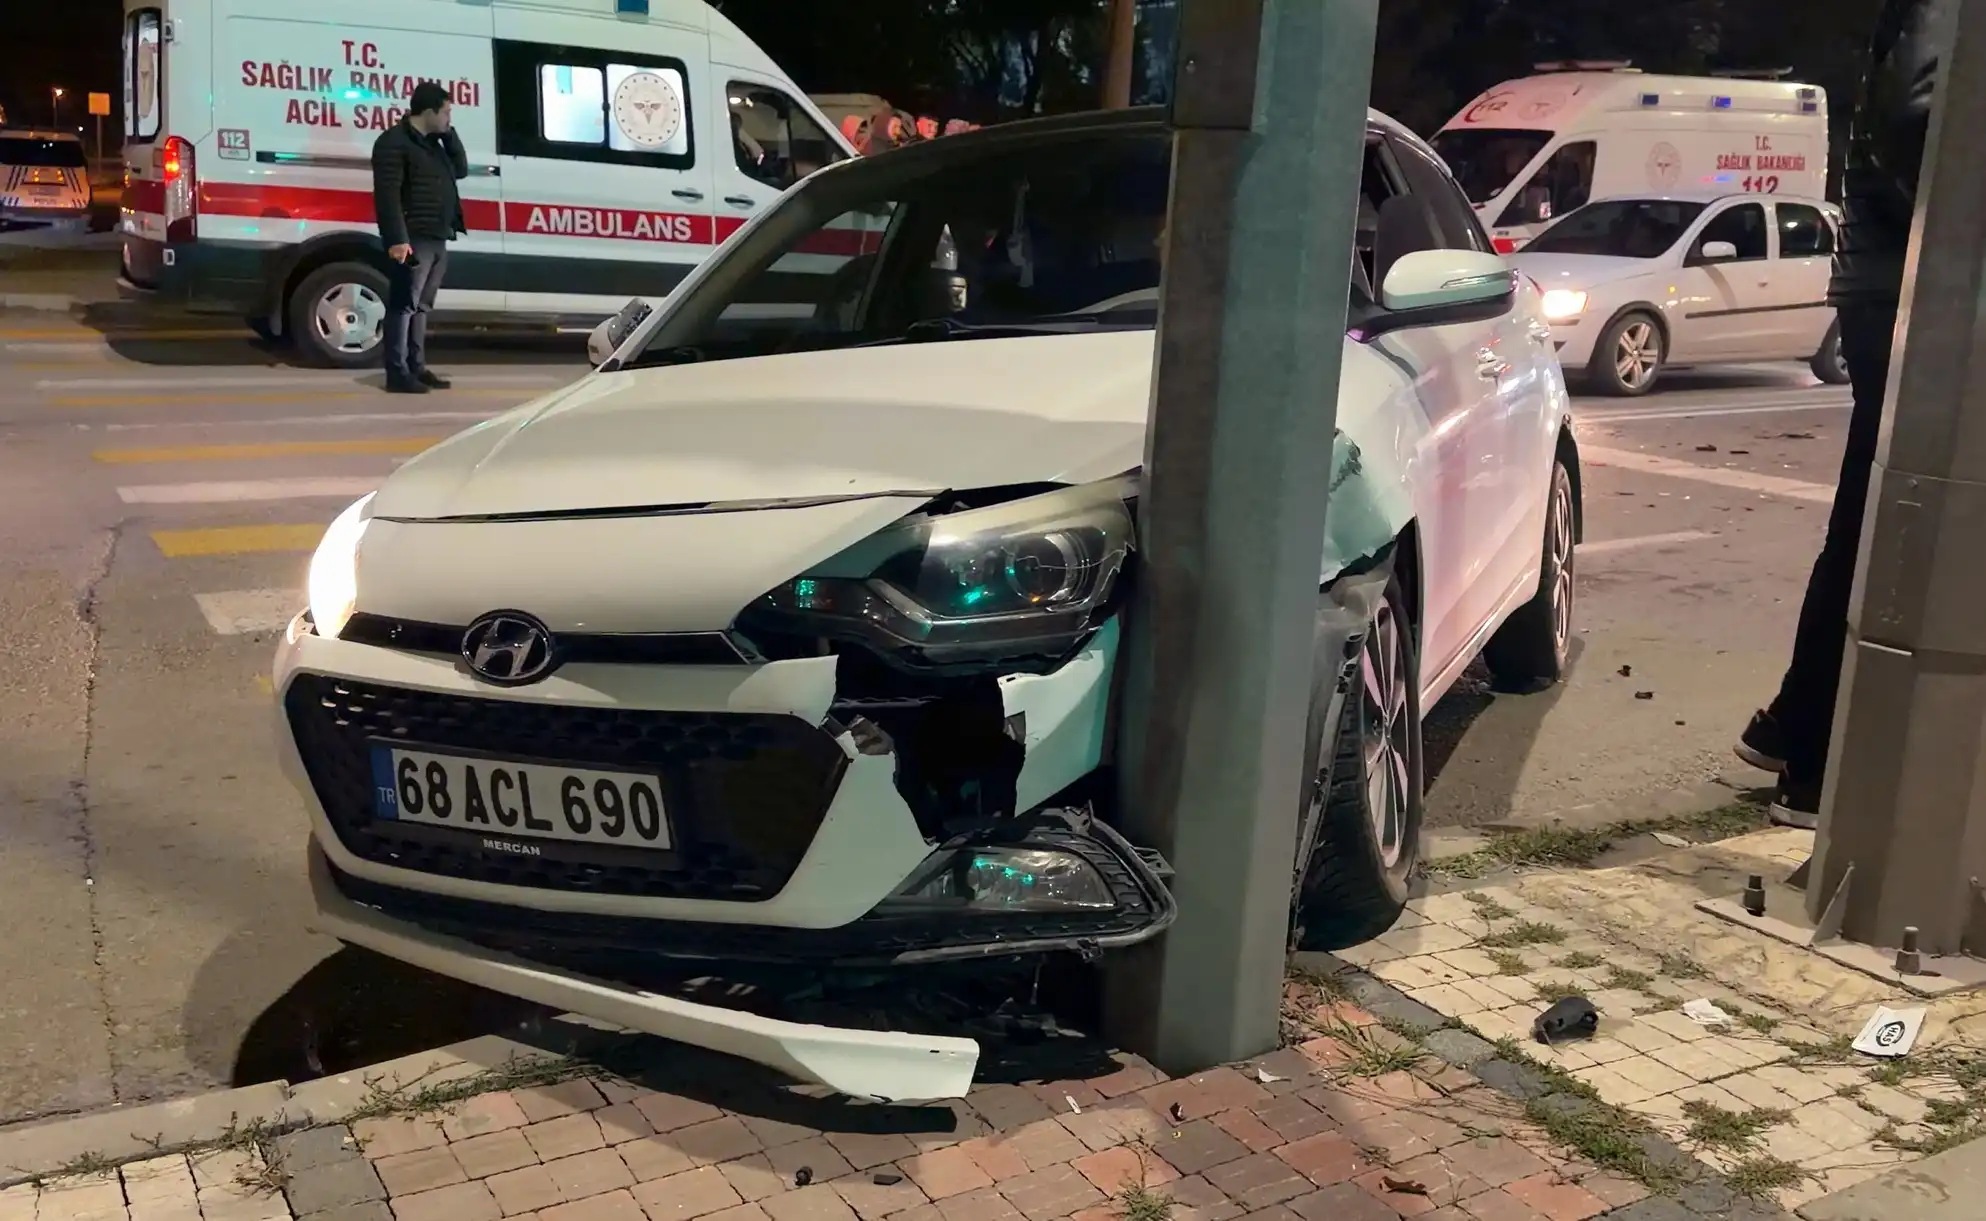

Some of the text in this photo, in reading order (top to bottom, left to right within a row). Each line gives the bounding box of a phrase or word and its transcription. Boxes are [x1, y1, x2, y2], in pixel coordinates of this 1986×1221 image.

[341, 39, 386, 69] T.C.
[241, 58, 480, 107] SAĞLIK BAKAIĞI
[285, 96, 342, 128] ACİL
[221, 131, 246, 148] 112
[1754, 135, 1772, 151] T.C.
[526, 206, 692, 242] AMBULANS
[377, 786, 396, 806] TR
[397, 756, 661, 842] 68 ACL 690
[482, 838, 541, 856] MERCAN
